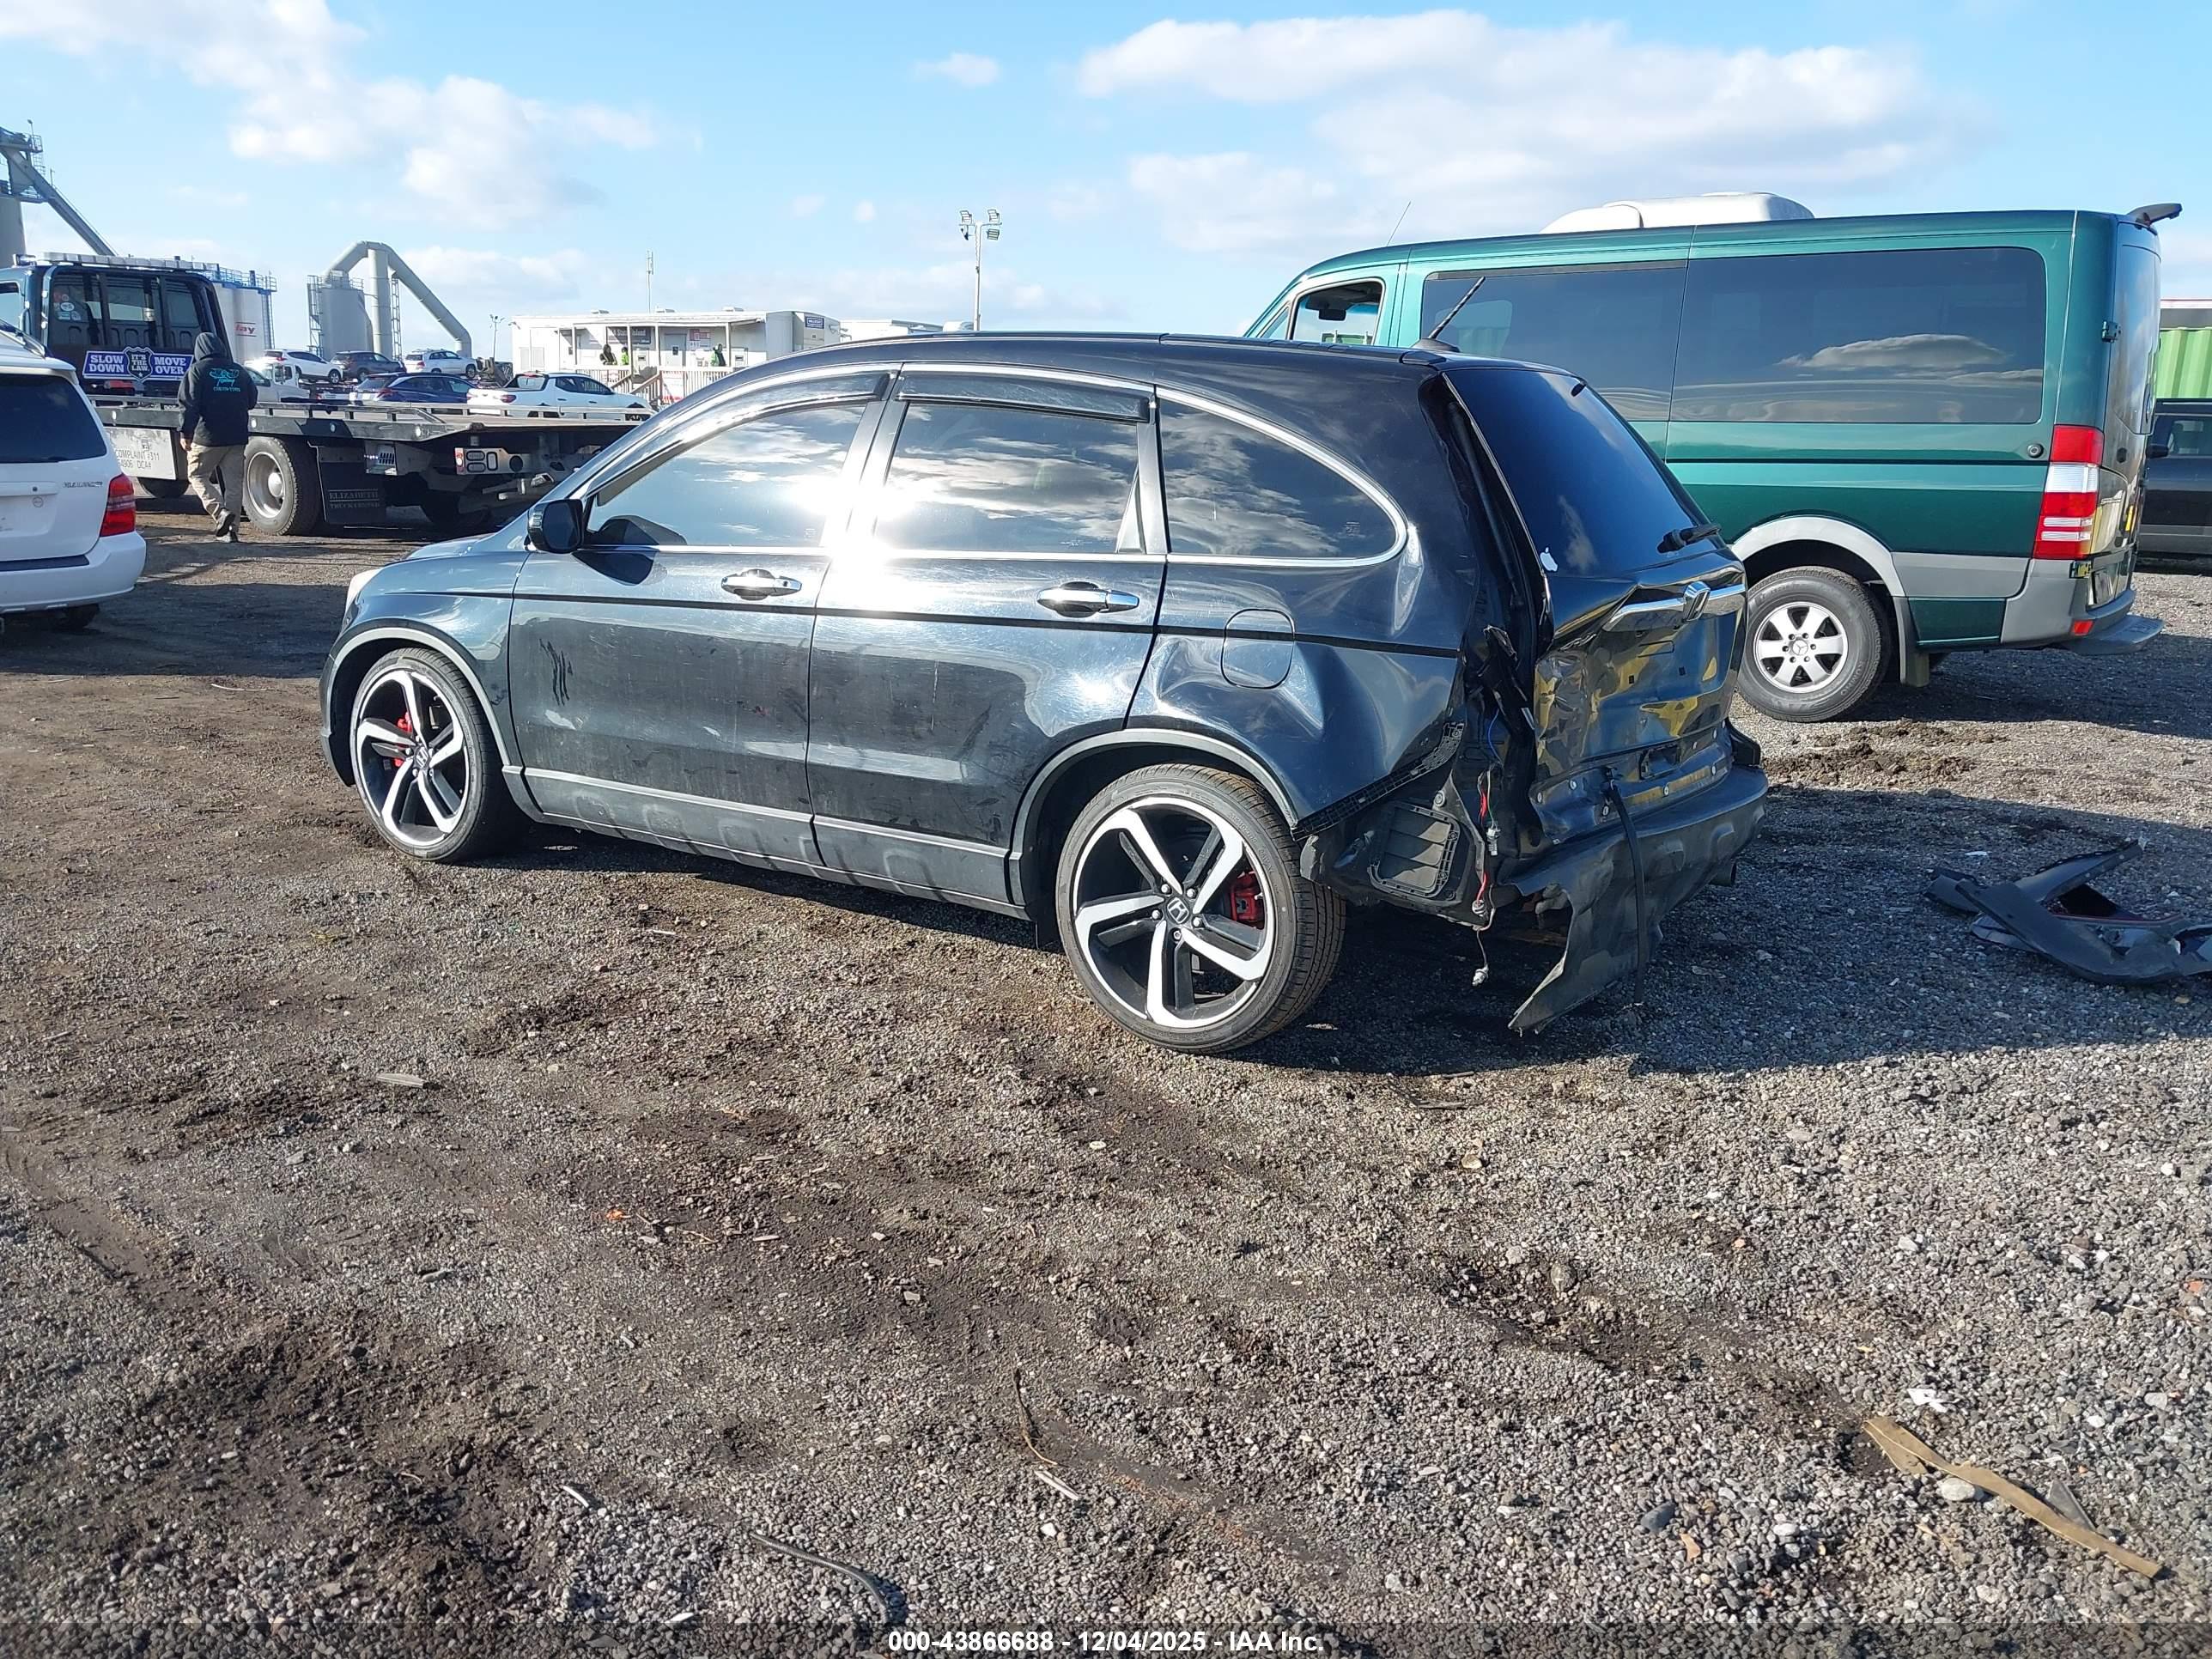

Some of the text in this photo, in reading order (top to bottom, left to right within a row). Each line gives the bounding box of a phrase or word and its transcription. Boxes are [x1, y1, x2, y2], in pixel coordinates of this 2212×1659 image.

[90, 355, 124, 364] SLOW
[154, 356, 186, 367] MOVE
[88, 363, 125, 374] DOWN
[155, 365, 185, 374] OVER
